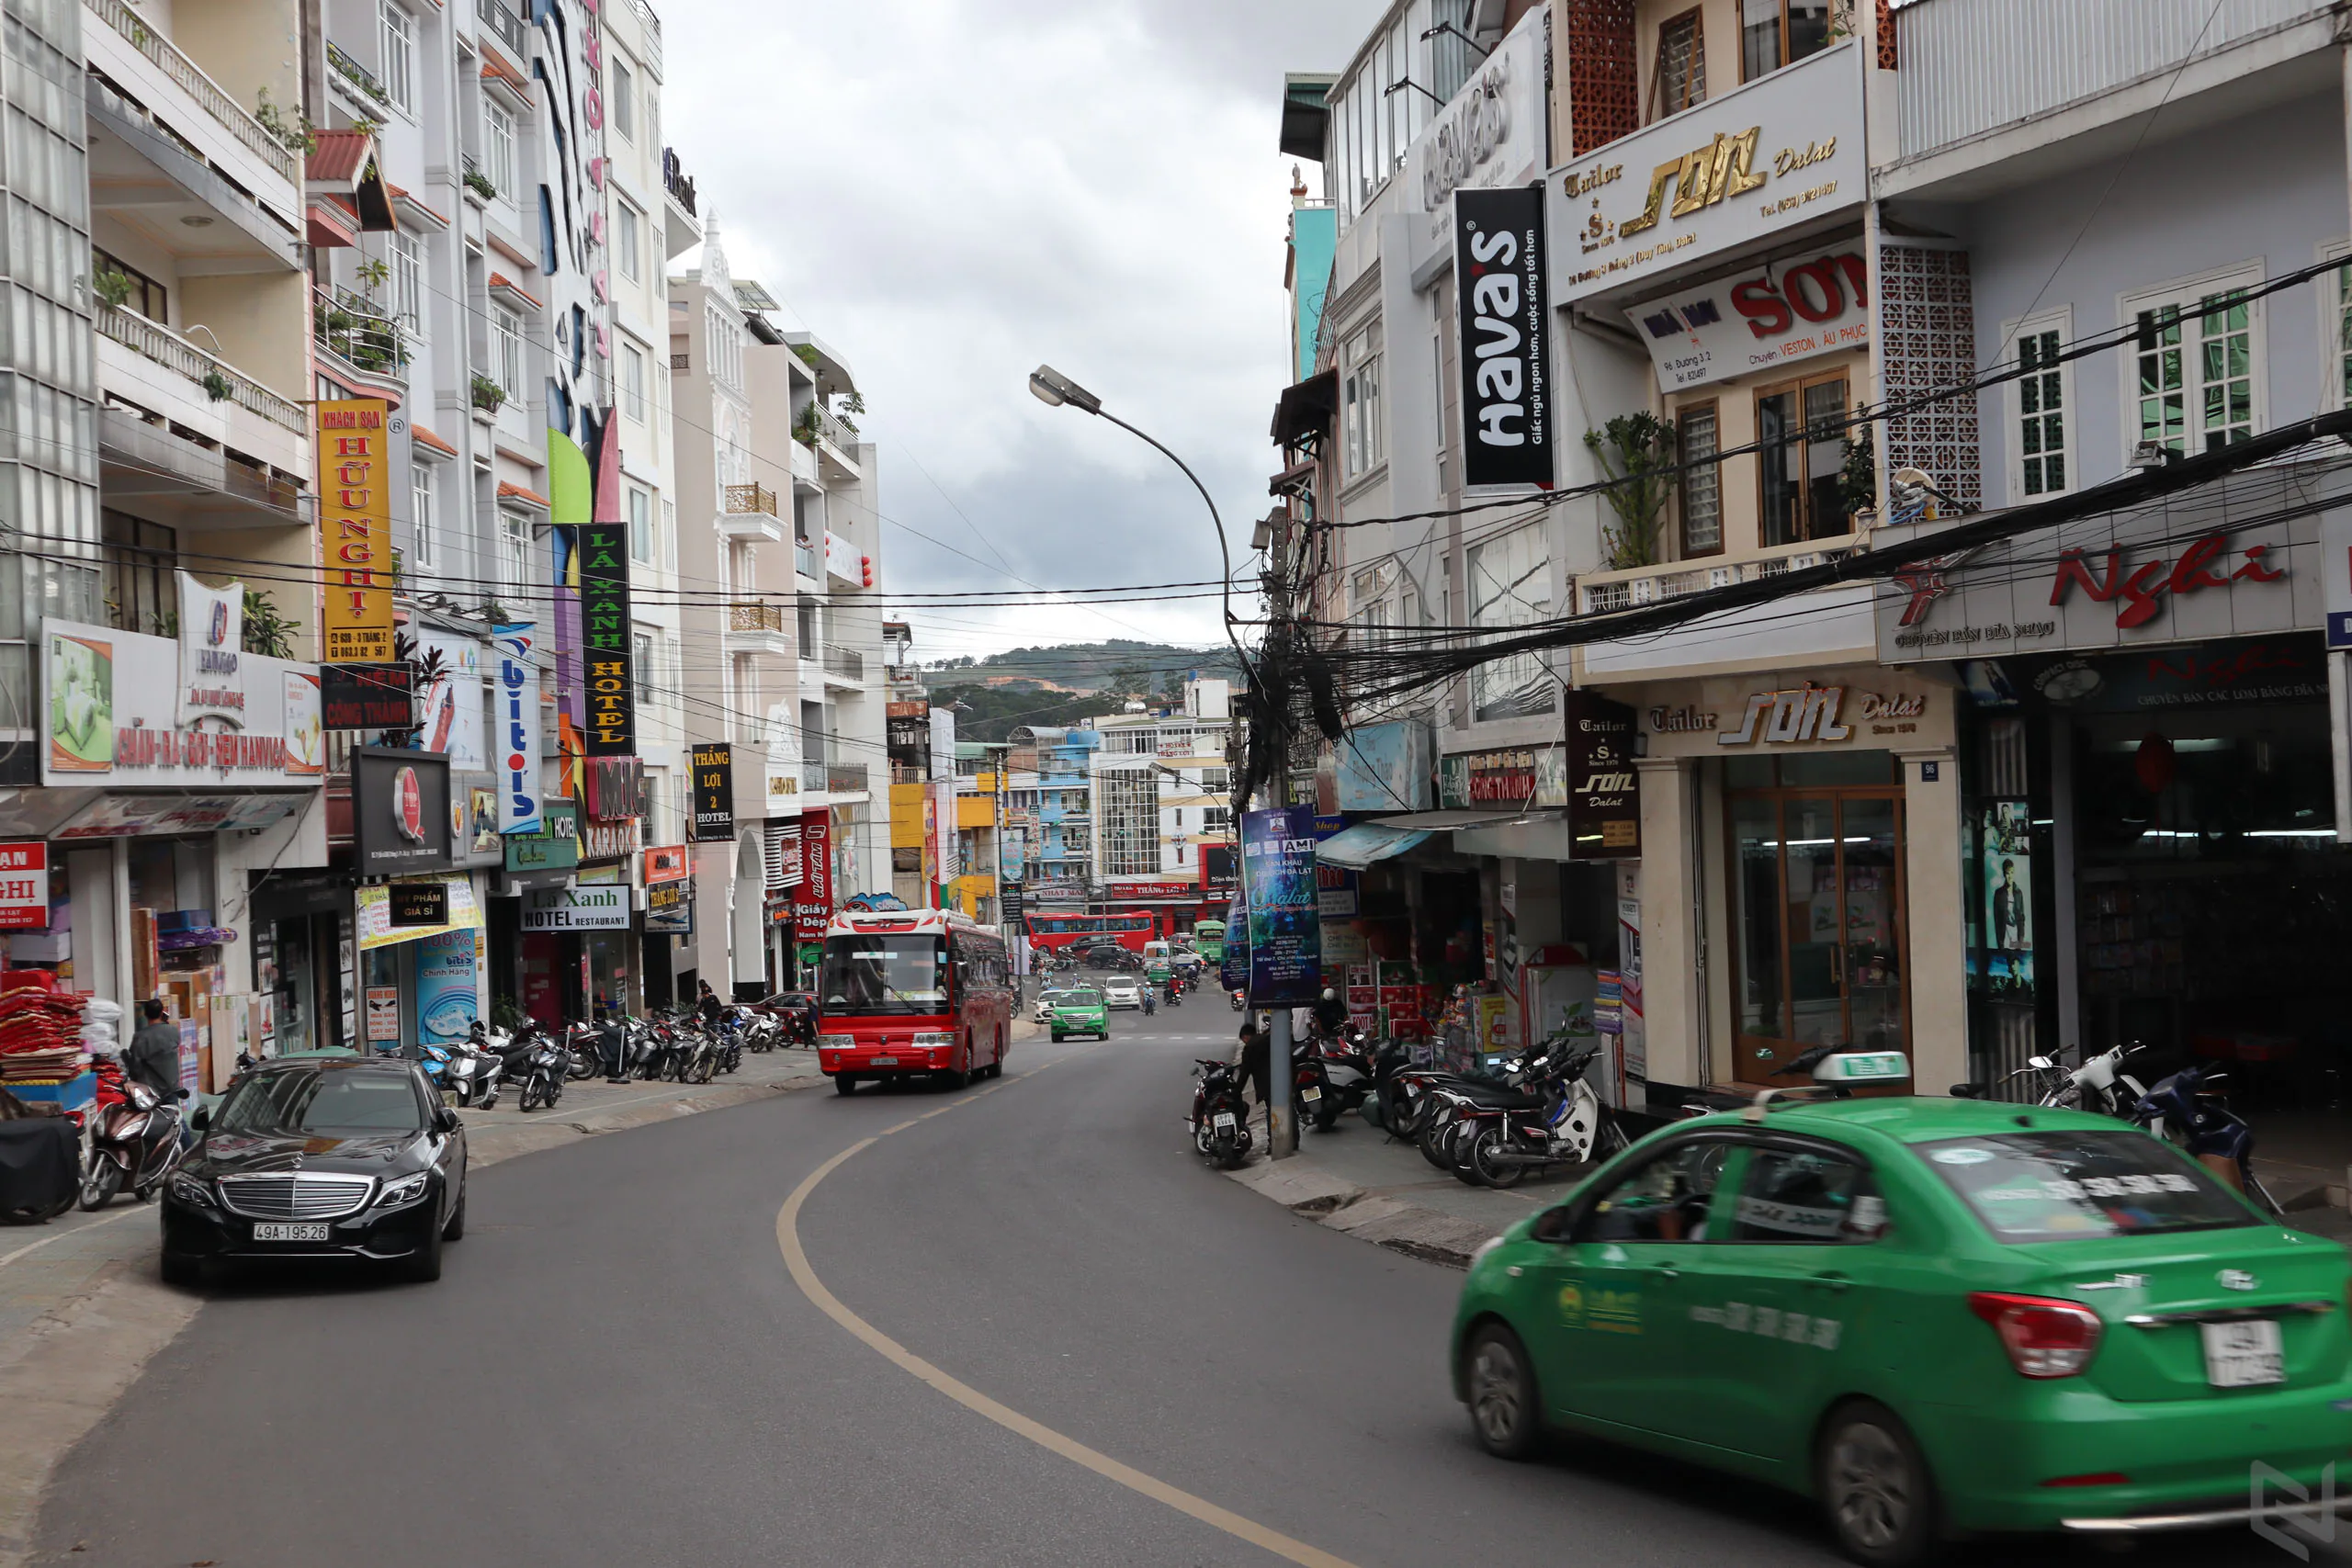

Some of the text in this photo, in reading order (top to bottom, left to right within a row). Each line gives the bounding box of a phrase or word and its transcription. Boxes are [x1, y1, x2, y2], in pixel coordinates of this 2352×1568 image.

[1773, 136, 1836, 177] Dalat
[1564, 163, 1623, 197] Tailor
[1524, 229, 1544, 445] Giấc ngủ ngon hơn, cuộc sống tốt hơn
[1780, 333, 1815, 356] VESTON
[1824, 330, 1837, 347] ÂU
[1840, 324, 1868, 344] PHỤC
[323, 409, 382, 432] KHÁCH SẠN
[592, 661, 625, 743] HOTEL
[1860, 693, 1927, 721] Dalat
[1579, 719, 1627, 732] Tailor
[1650, 705, 1717, 734] Tailor
[694, 745, 729, 766] THẮNG
[1597, 746, 1610, 759] S
[1925, 763, 1935, 774] 96
[703, 773, 722, 790] LỢI
[709, 795, 718, 809] 2
[1589, 796, 1623, 807] Dalat
[696, 812, 732, 823] HOTEL
[554, 817, 575, 839] HOTEL
[565, 889, 617, 908] Xanh
[525, 911, 625, 927] HOTEL RESTAURANT
[803, 917, 827, 928] Dép
[254, 1225, 327, 1240] 49A-195.26
